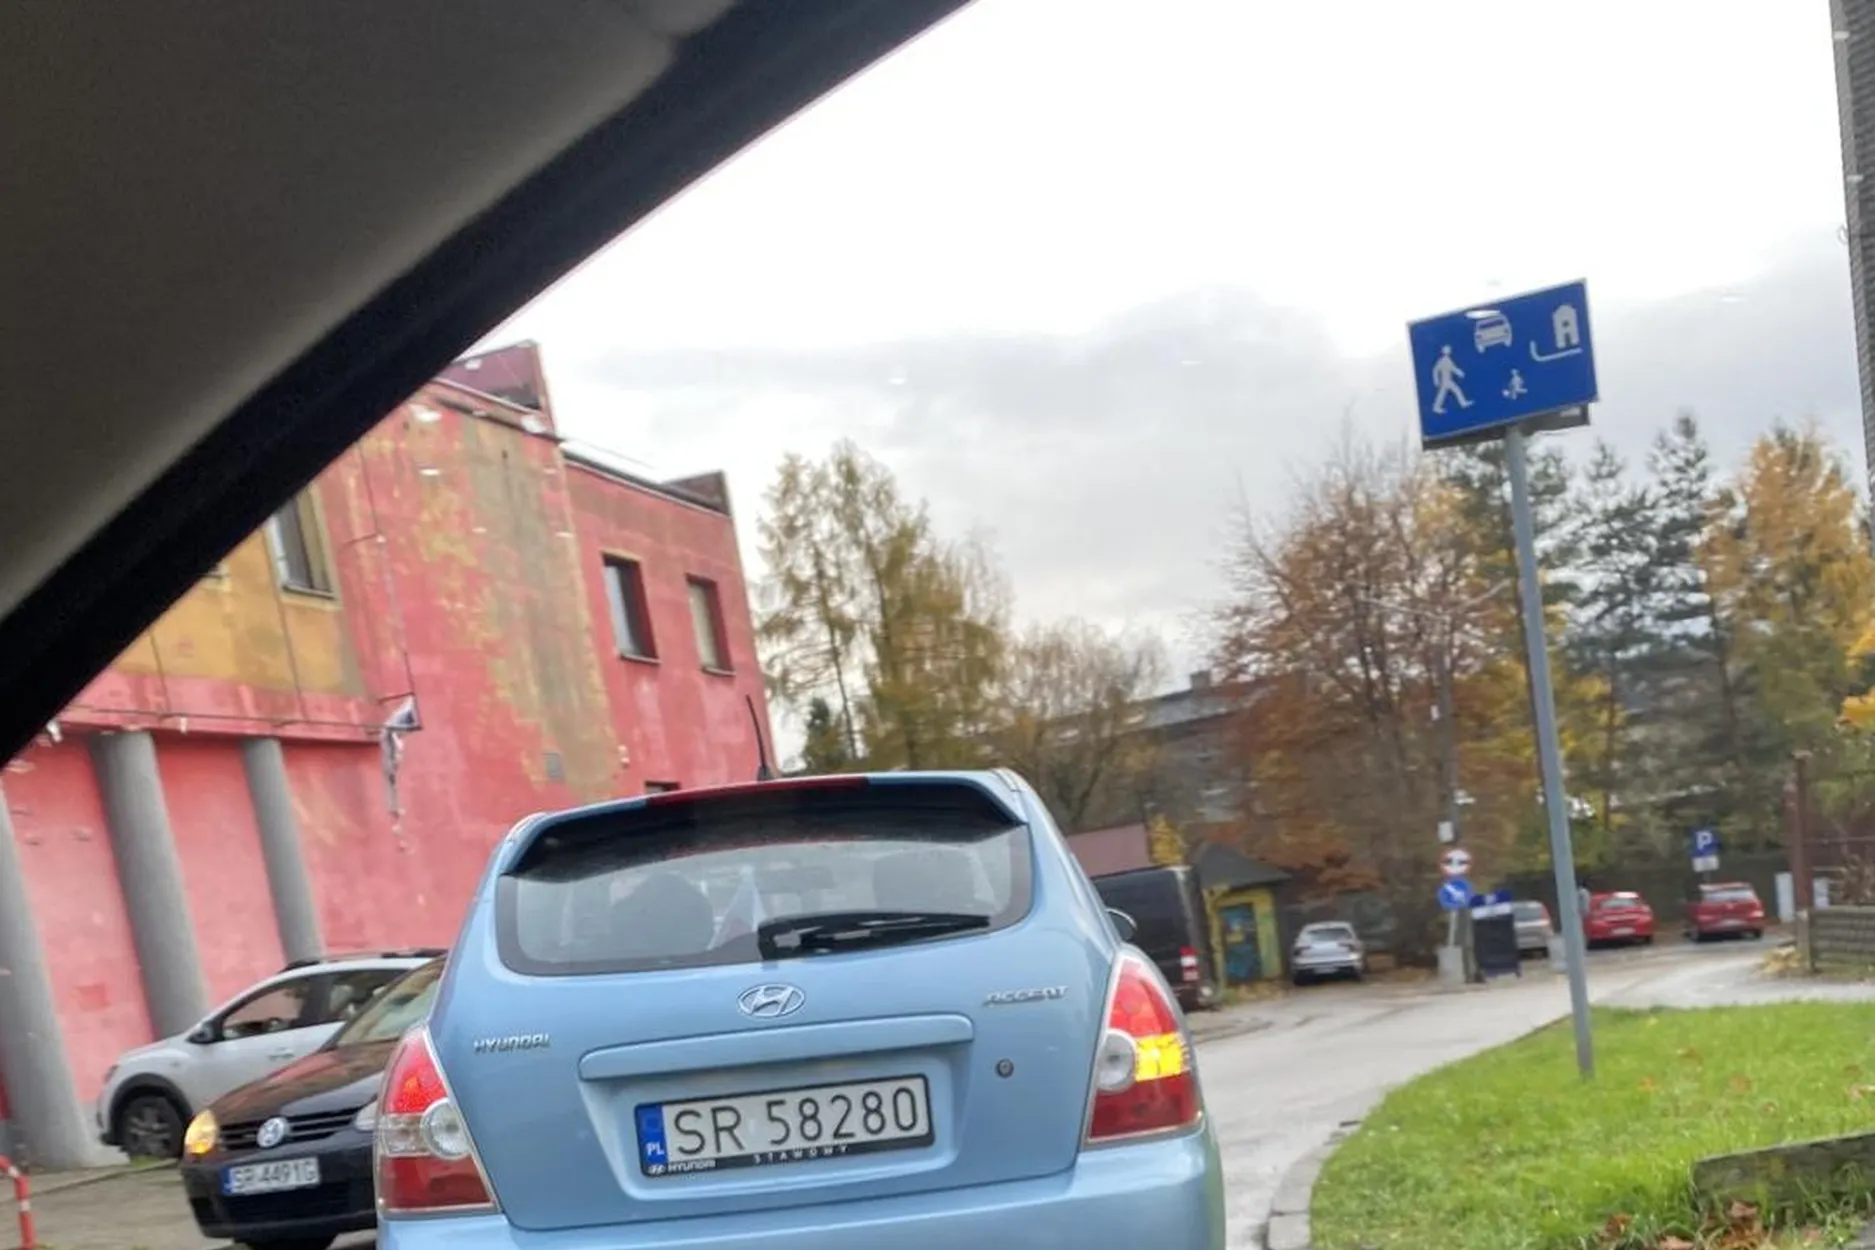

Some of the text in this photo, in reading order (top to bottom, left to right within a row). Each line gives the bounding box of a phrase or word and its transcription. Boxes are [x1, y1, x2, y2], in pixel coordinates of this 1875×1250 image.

[1696, 830, 1714, 851] P
[982, 984, 1069, 1006] ACCENT
[473, 1032, 552, 1053] HYUNDAI
[674, 1086, 919, 1155] SR 58280
[645, 1141, 665, 1156] PL
[257, 1159, 315, 1185] 4491G
[667, 1159, 717, 1173] HYUNDAI
